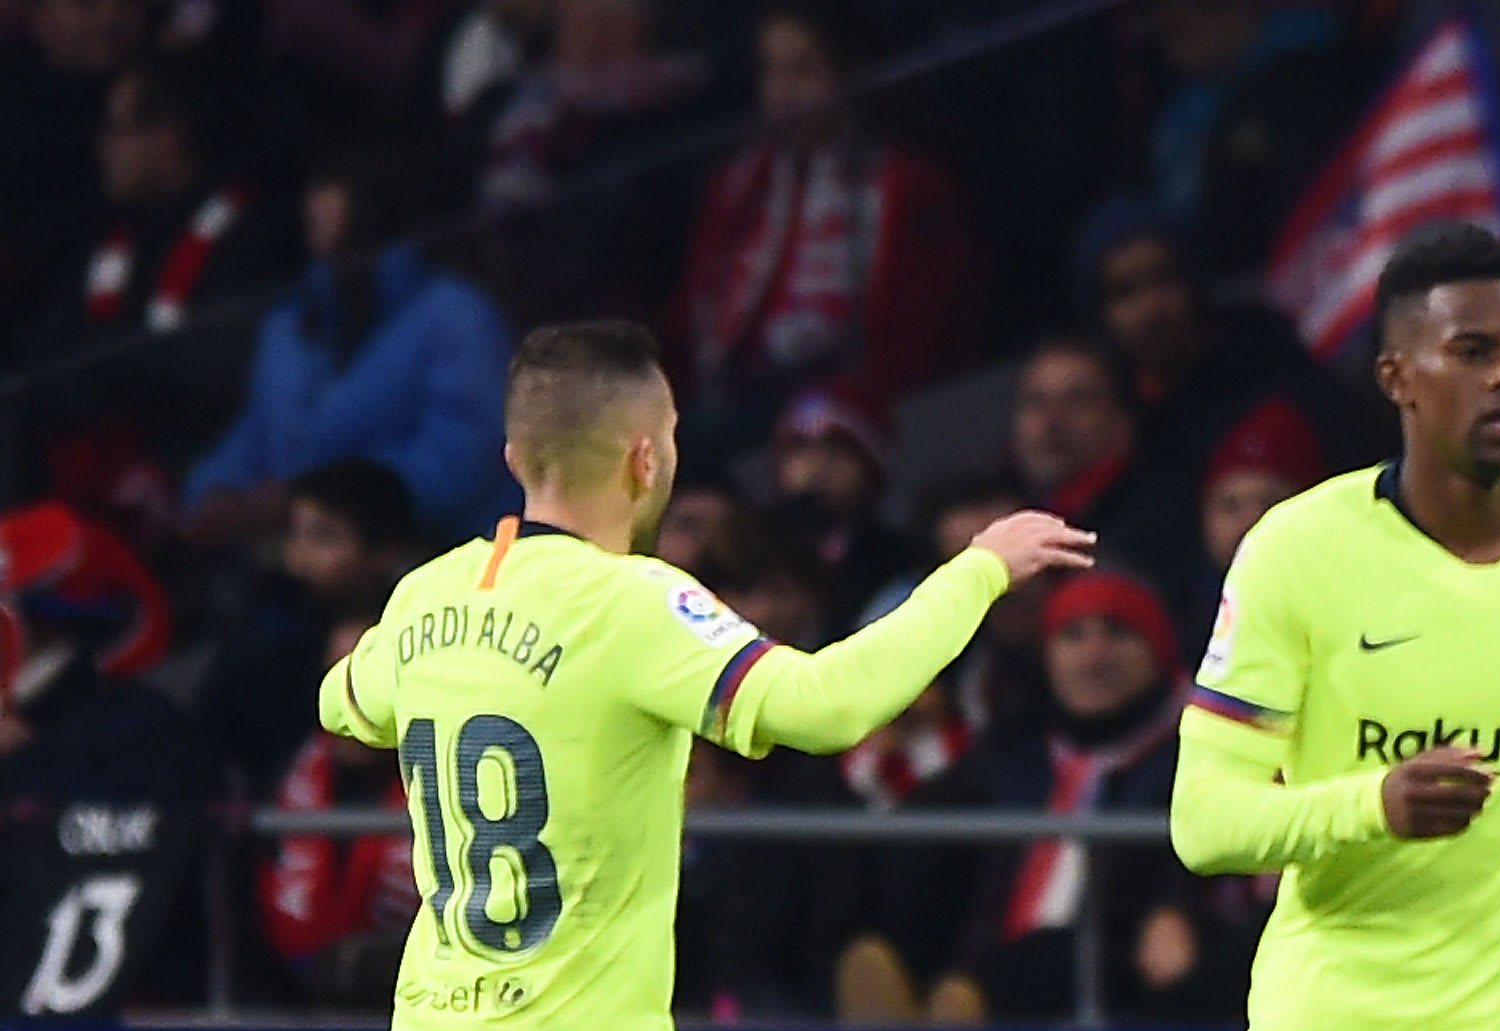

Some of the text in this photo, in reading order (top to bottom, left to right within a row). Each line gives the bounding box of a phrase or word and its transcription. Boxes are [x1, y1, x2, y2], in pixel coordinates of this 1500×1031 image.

[398, 605, 563, 687] ORDI ALBA
[401, 714, 563, 955] 18
